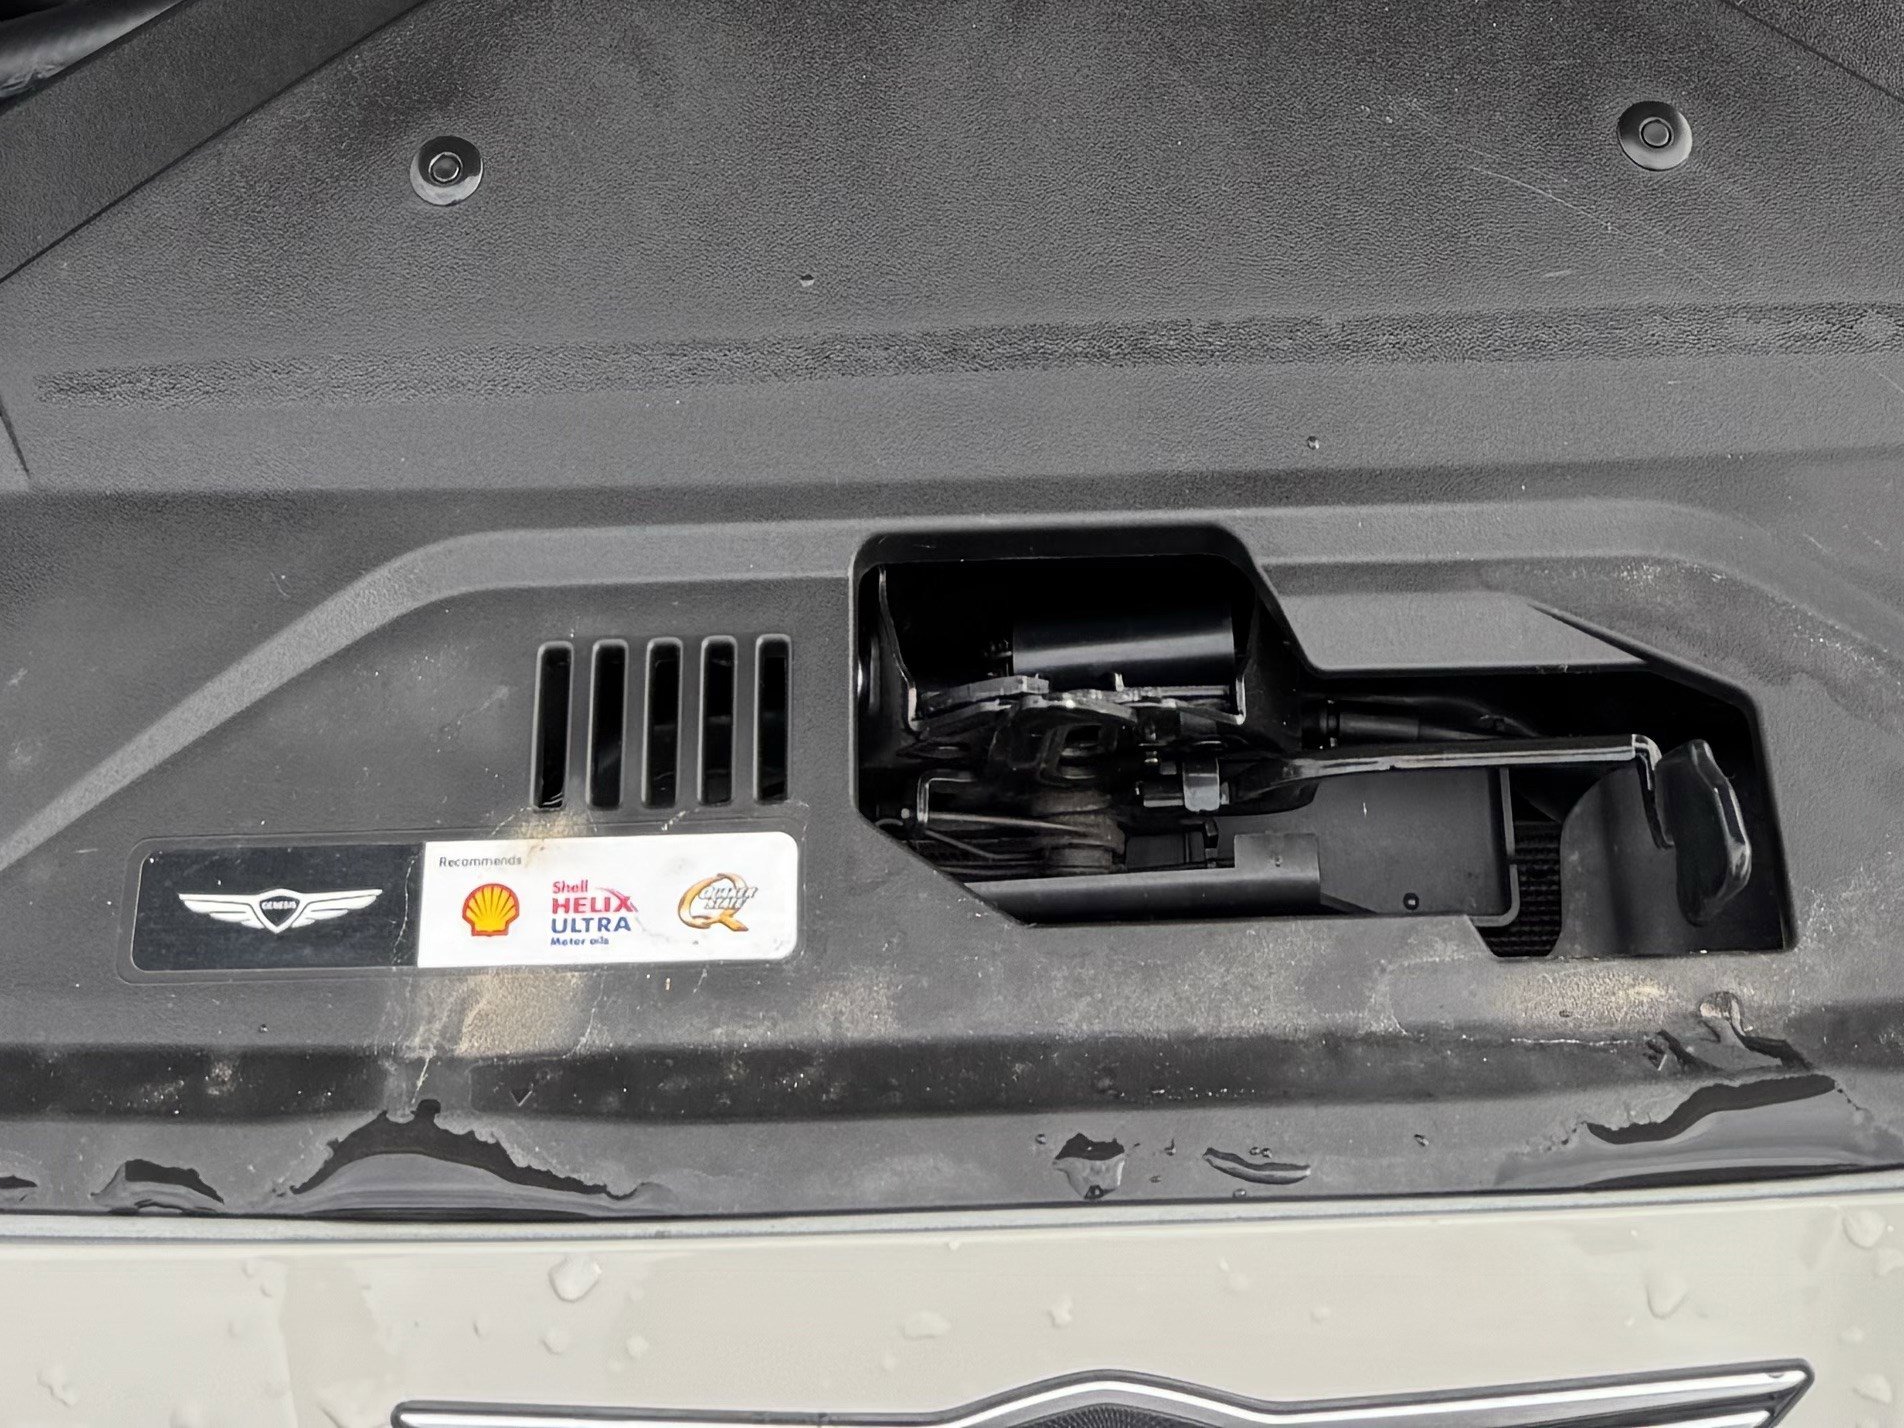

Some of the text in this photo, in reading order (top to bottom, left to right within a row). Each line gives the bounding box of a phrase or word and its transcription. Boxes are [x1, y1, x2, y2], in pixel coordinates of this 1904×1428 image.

[439, 855, 522, 868] Recommends
[552, 879, 589, 894] Shell
[262, 901, 297, 911] GENESIS
[552, 894, 636, 914] HELIX
[551, 916, 632, 934] ULTRA
